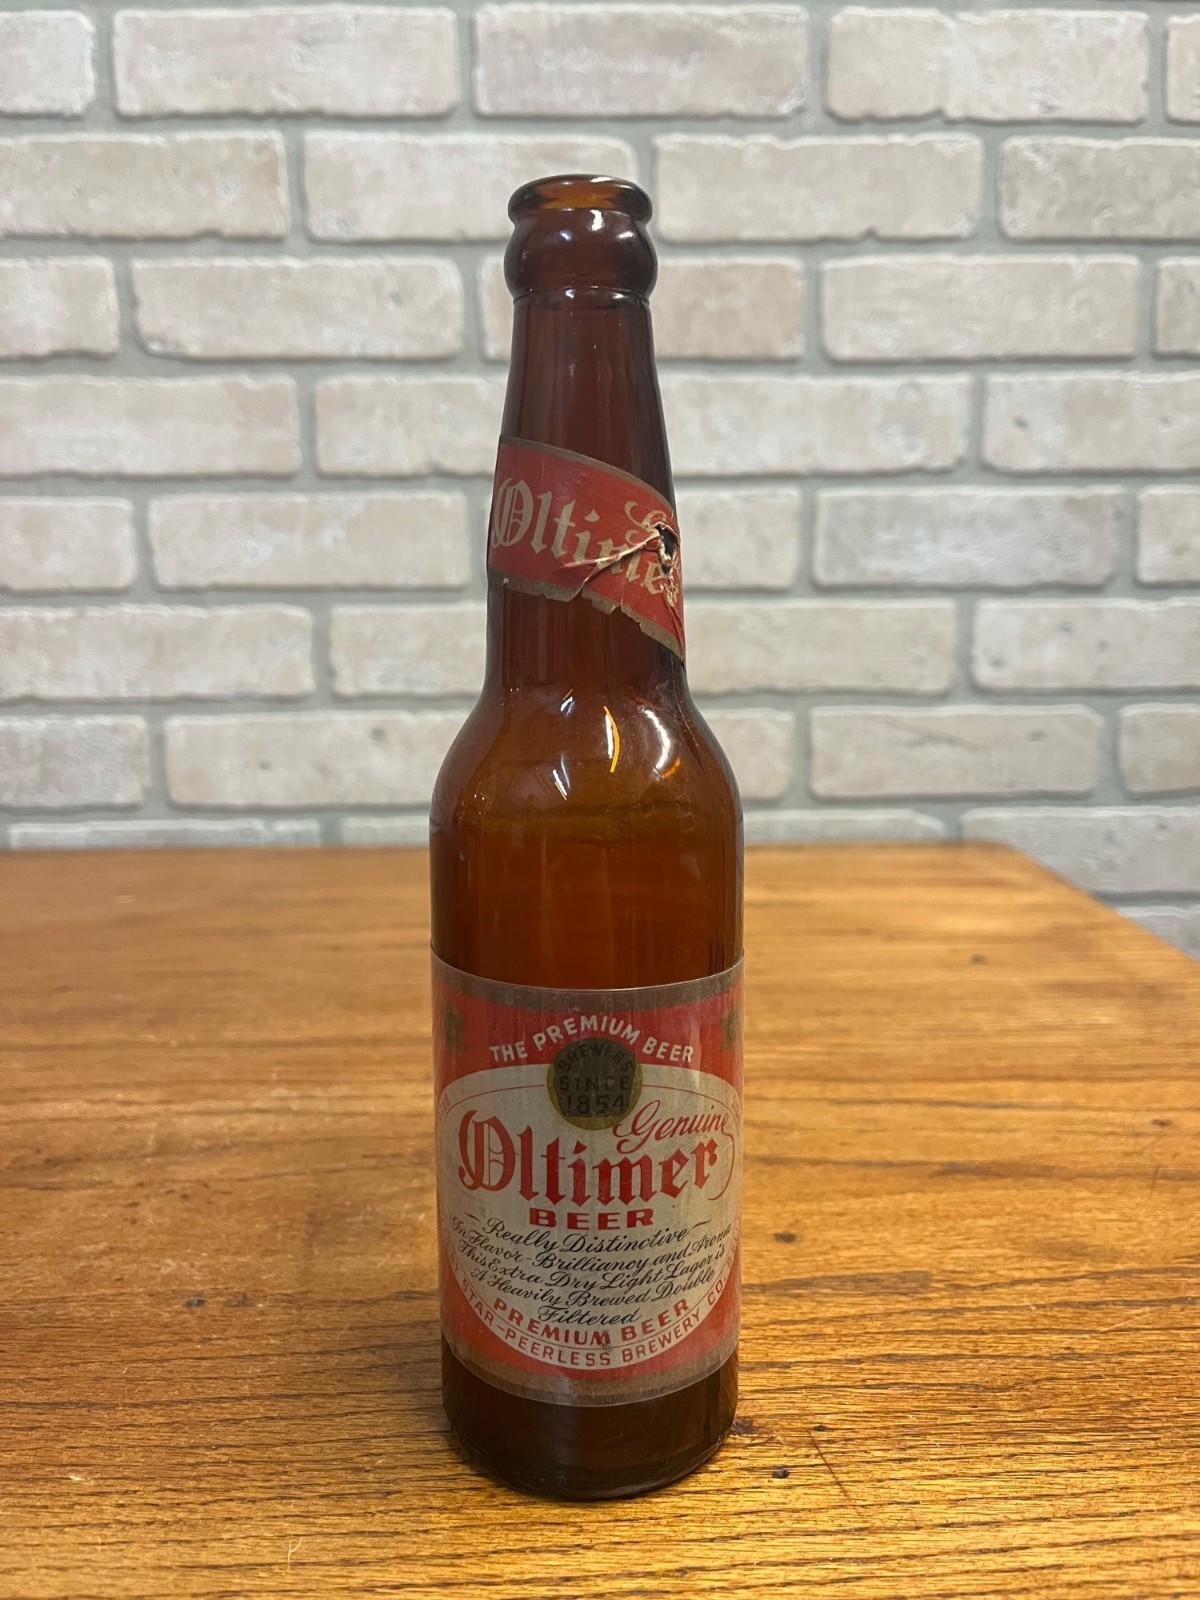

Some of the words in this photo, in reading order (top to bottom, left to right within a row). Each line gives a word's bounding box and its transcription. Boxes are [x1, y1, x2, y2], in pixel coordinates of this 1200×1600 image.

[489, 1040, 528, 1063] THE
[532, 1015, 640, 1049] PREMIUM
[641, 1036, 694, 1063] BEER
[557, 1043, 634, 1072] BREWERS
[559, 1075, 632, 1092] SINCE
[566, 1094, 626, 1114] 1854
[612, 1099, 731, 1154] Genuine
[458, 1110, 718, 1207] Oltimer
[482, 1217, 559, 1254] Really
[559, 1227, 690, 1253] Distinctive
[529, 1207, 653, 1230] BEER
[488, 1258, 544, 1284] Extra
[544, 1271, 600, 1293] Dry
[600, 1270, 665, 1292] Light
[665, 1251, 714, 1281] Lager
[532, 1251, 651, 1277] Brilliancy
[650, 1246, 692, 1268] and
[564, 1288, 652, 1307] Brewed
[652, 1267, 716, 1300] Double
[492, 1296, 612, 1347] PREMIUM
[620, 1298, 690, 1342] BEER
[537, 1305, 642, 1327] Filtered
[622, 1308, 700, 1363] BREWERY
